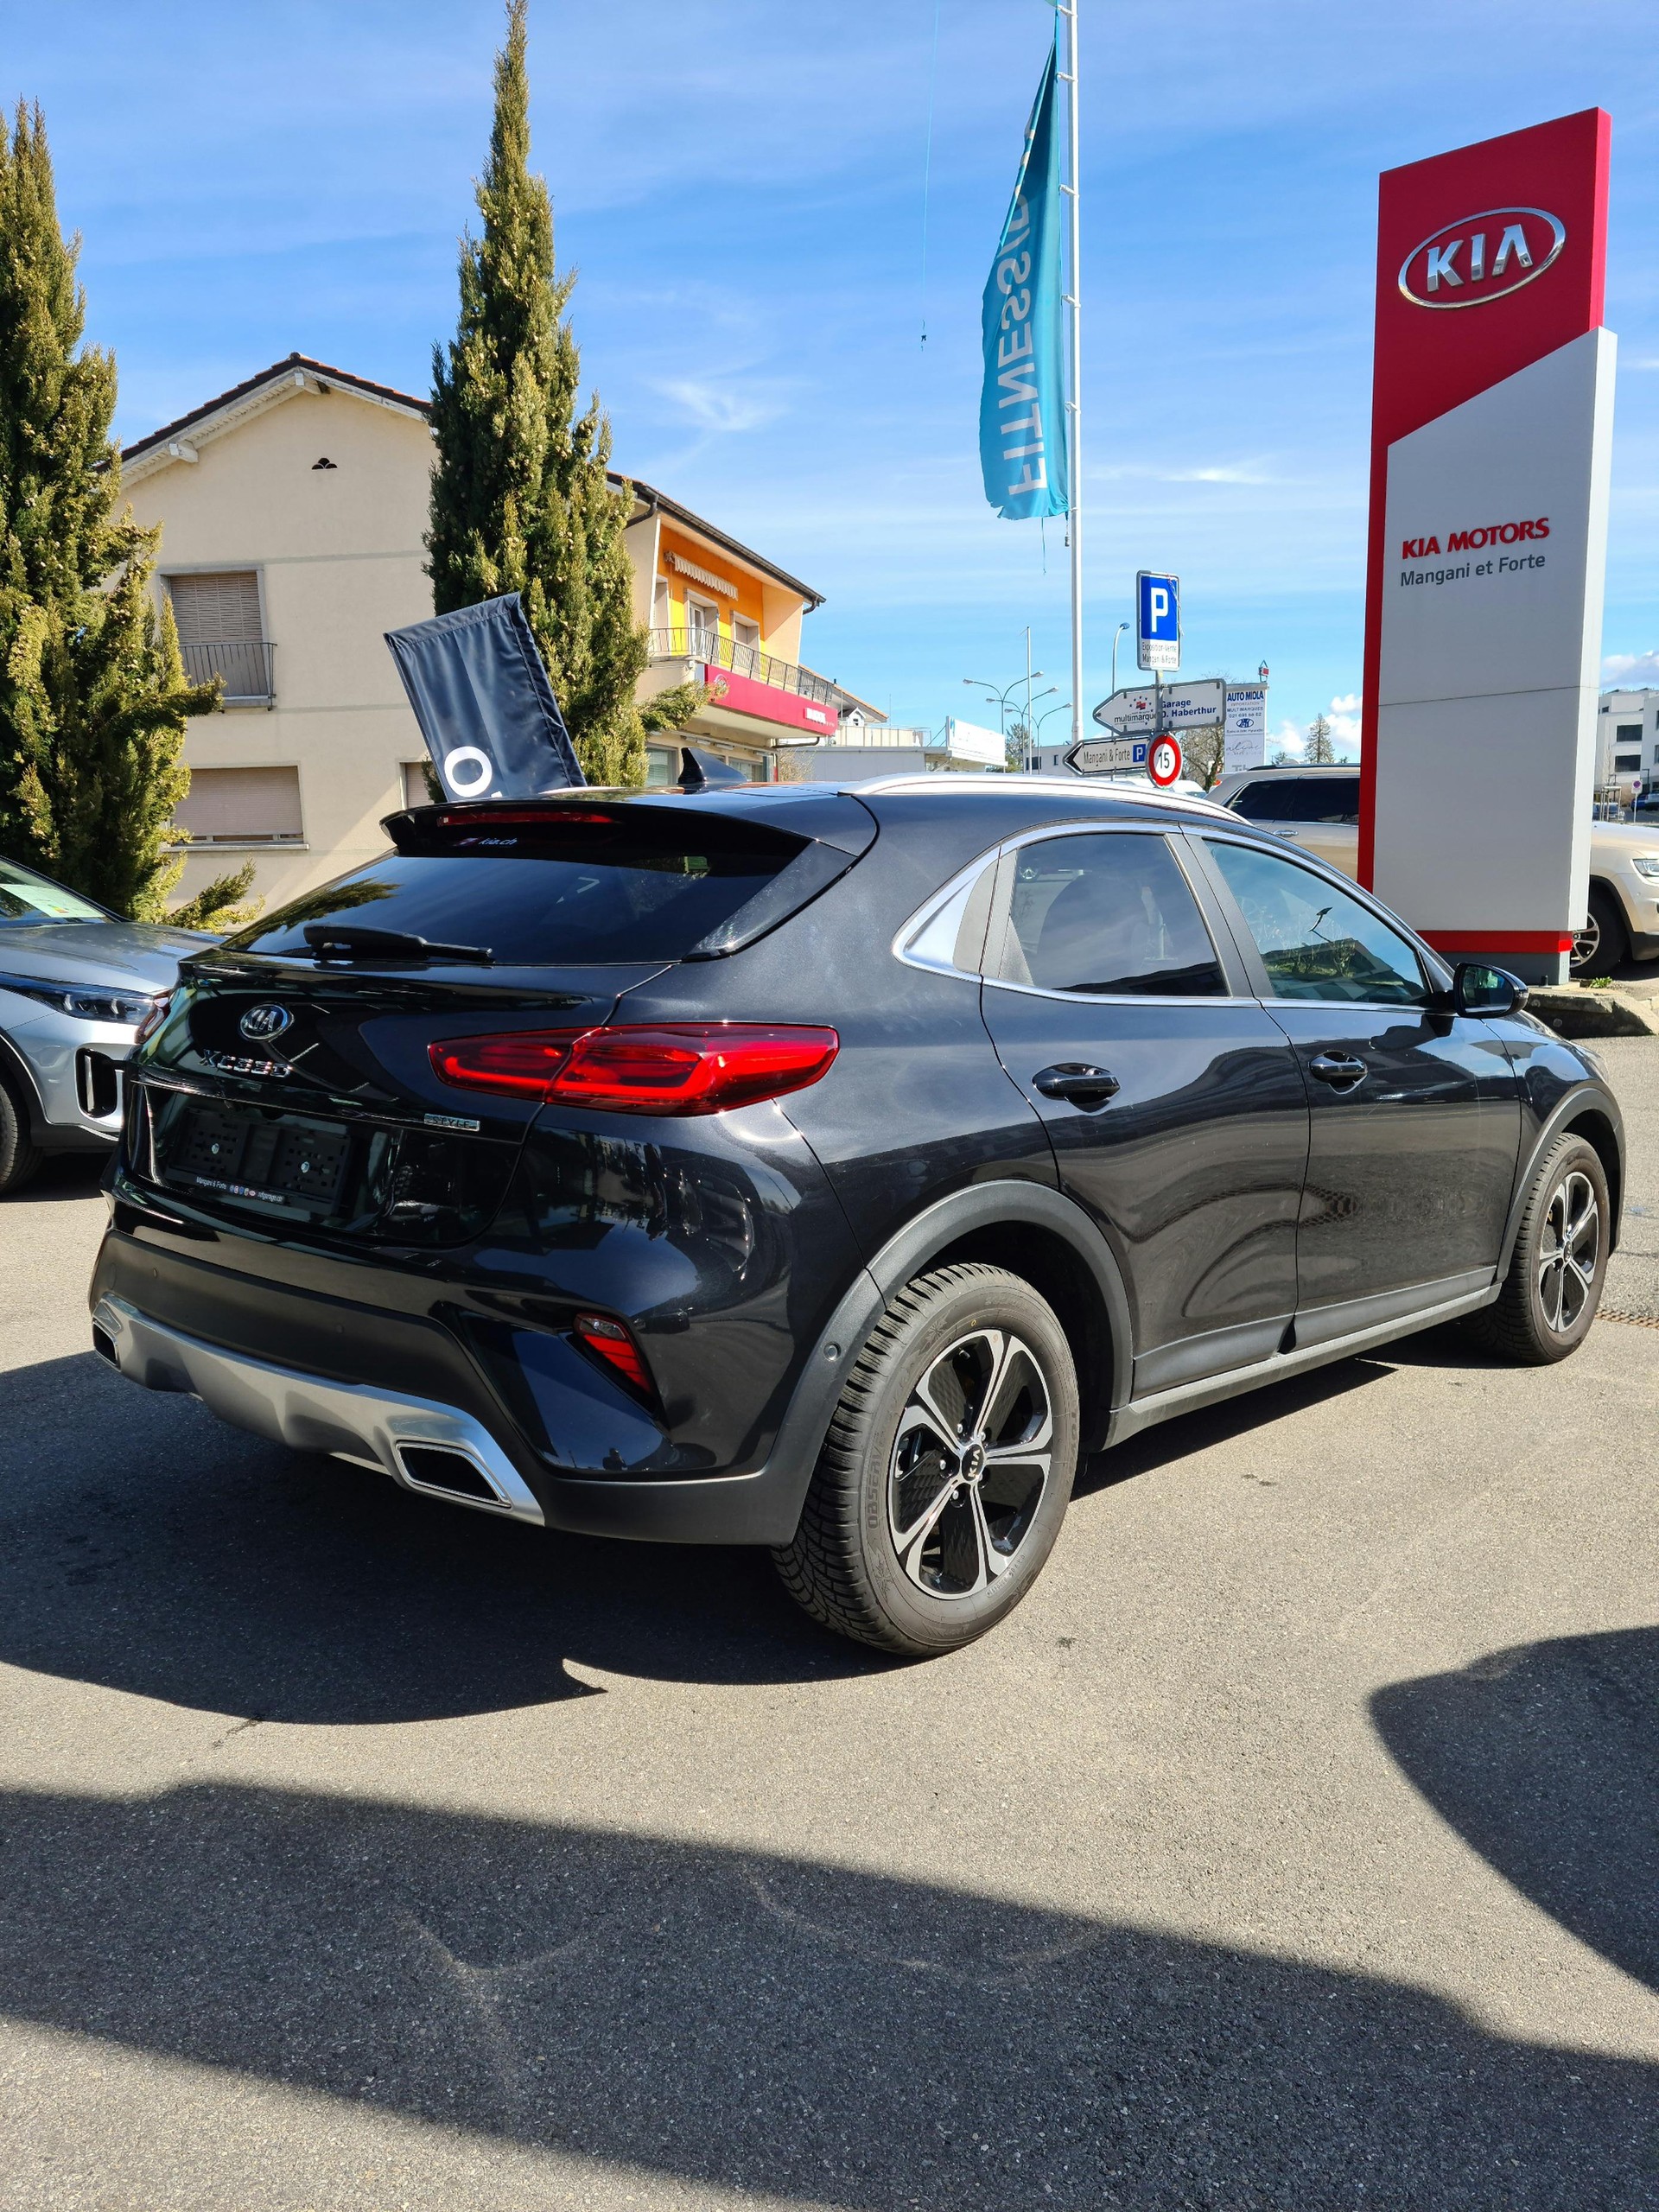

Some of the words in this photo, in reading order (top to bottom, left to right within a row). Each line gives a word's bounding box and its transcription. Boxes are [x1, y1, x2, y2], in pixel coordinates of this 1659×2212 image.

[1427, 224, 1534, 292] KIA
[1402, 536, 1440, 560] KIA
[1447, 518, 1550, 553] MOTORS
[1401, 563, 1470, 587] Mangani
[1476, 560, 1493, 576] et
[1499, 554, 1546, 573] Forte
[1151, 587, 1169, 632] P
[1162, 699, 1192, 709] Garage
[1227, 692, 1244, 701] AUTO
[1245, 690, 1263, 700] MIOLA
[1172, 707, 1217, 717] Haberthur
[1084, 748, 1108, 766] Mangani
[1109, 748, 1114, 761] &
[1115, 748, 1130, 761] Forte
[1136, 747, 1143, 760] P
[1158, 752, 1170, 769] 15
[433, 1116, 470, 1128] STYLE
[968, 1449, 981, 1478] KIA
